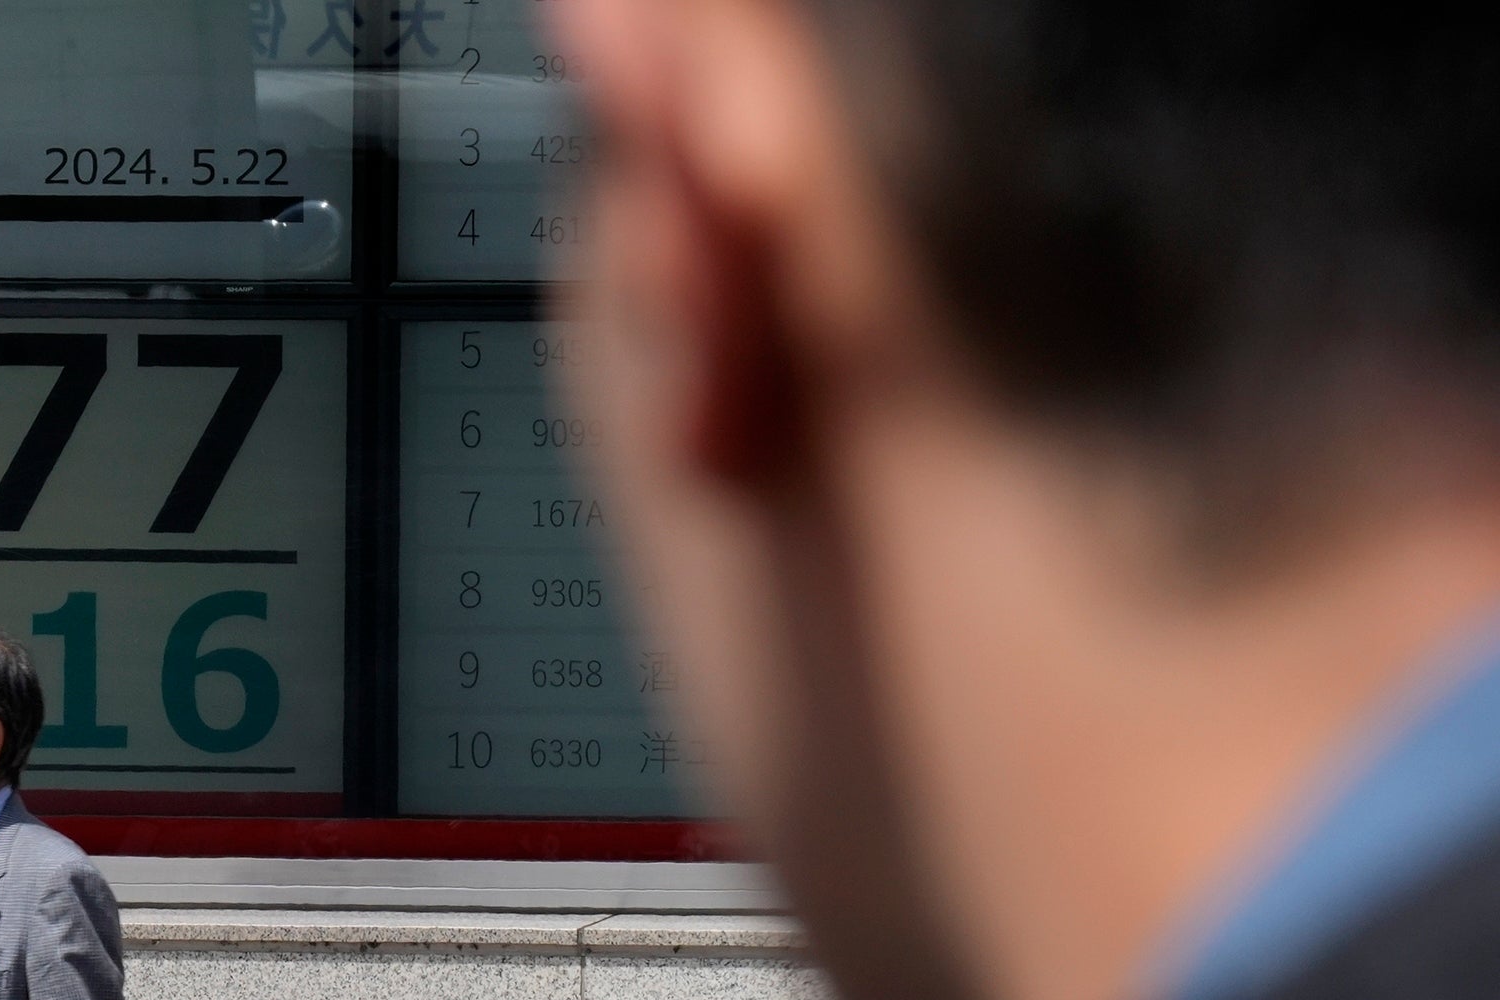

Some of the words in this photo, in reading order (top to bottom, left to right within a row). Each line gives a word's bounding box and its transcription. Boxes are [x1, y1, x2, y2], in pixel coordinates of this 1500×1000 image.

[460, 48, 481, 85] 2
[459, 128, 480, 166] 3
[530, 136, 590, 164] 425
[44, 147, 170, 186] 2024.
[190, 148, 289, 187] 5.22
[457, 209, 480, 246] 4
[530, 216, 588, 244] 461
[460, 331, 482, 369] 5
[460, 410, 482, 448] 6
[460, 491, 481, 528] 7
[532, 499, 605, 528] 167A
[459, 570, 482, 608] 8
[531, 578, 602, 608] 9305
[459, 651, 480, 688] 9
[531, 659, 603, 688] 6358
[639, 651, 678, 693] 酒
[448, 731, 493, 769] 10
[530, 738, 602, 768] 6330
